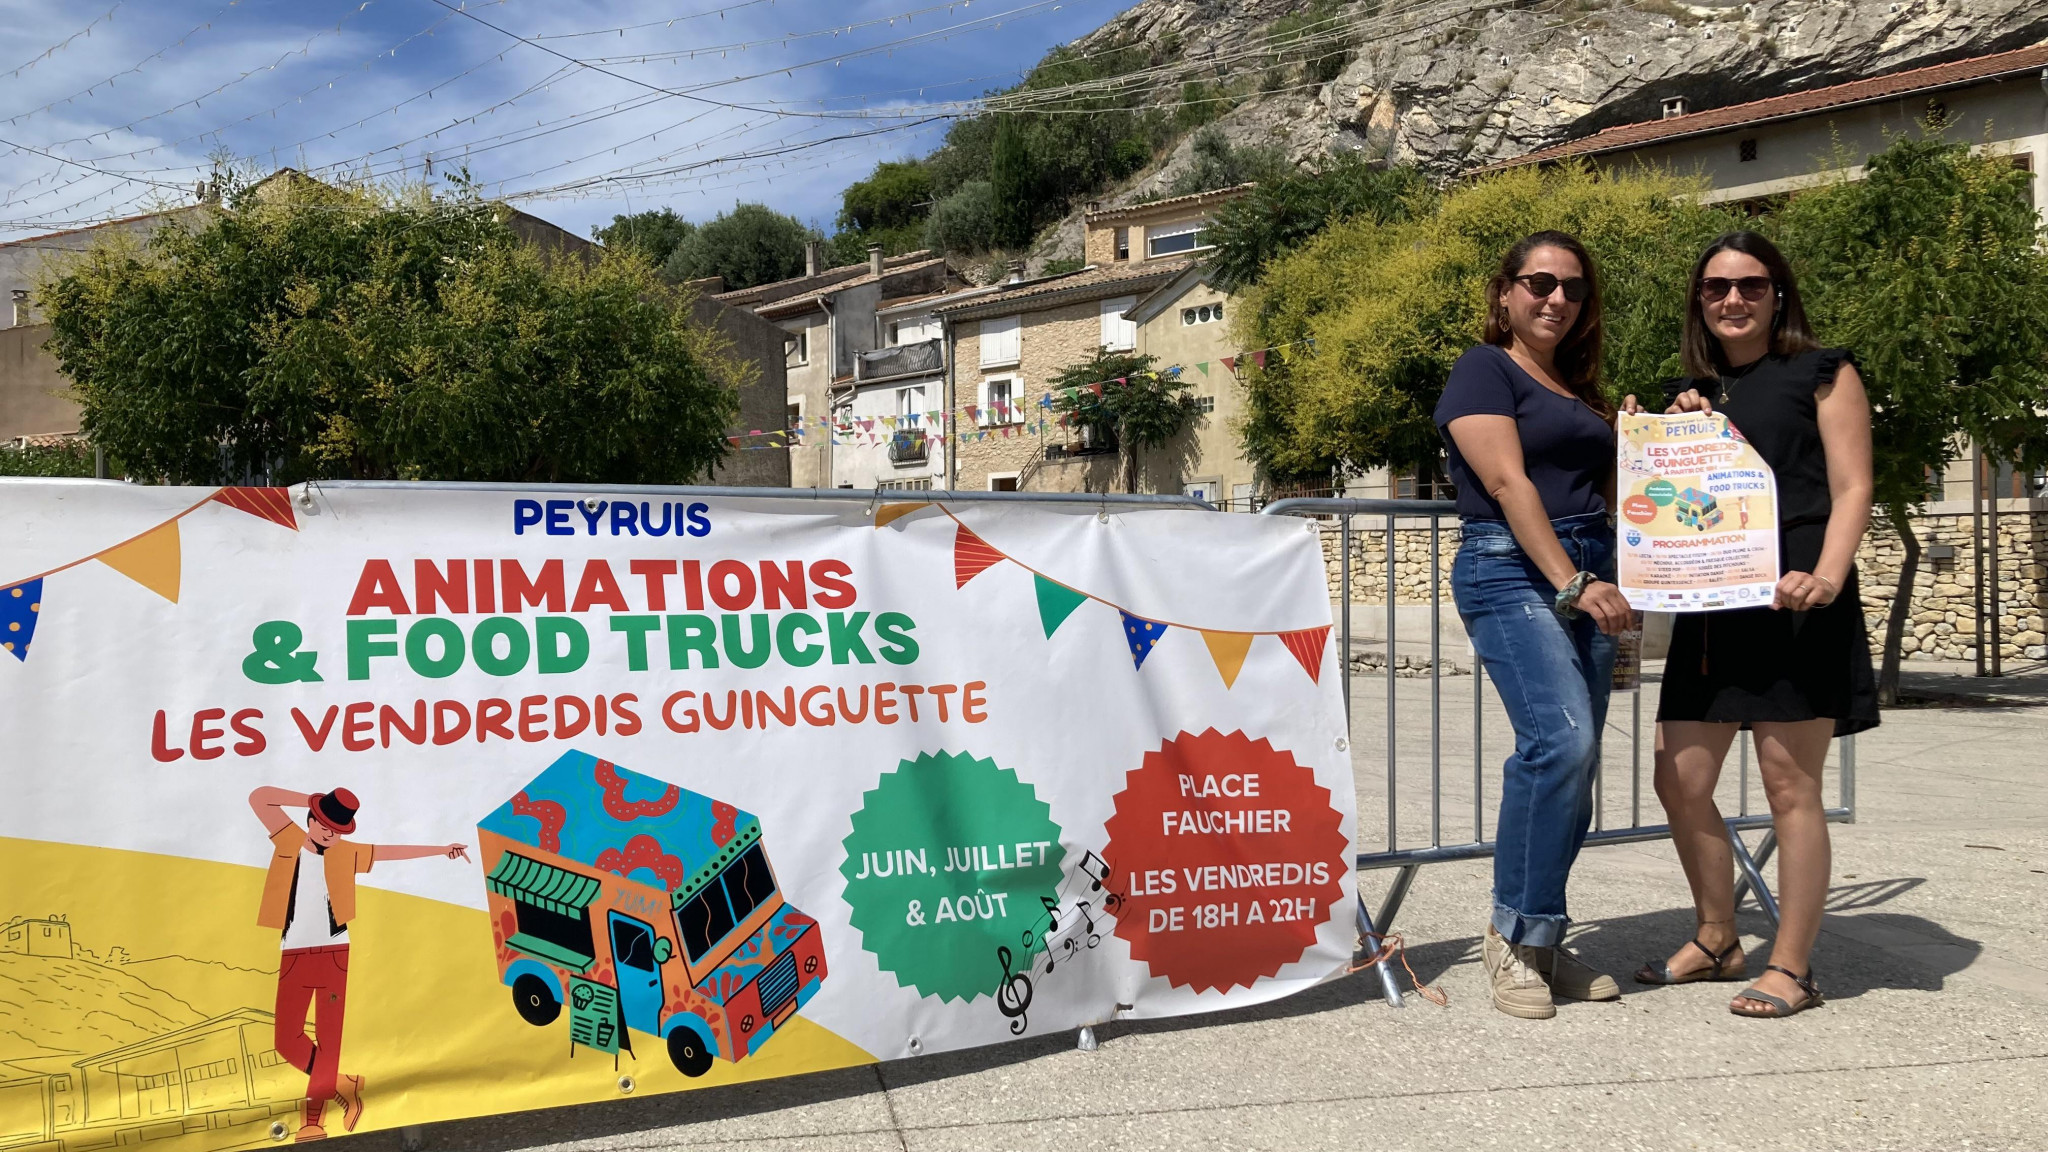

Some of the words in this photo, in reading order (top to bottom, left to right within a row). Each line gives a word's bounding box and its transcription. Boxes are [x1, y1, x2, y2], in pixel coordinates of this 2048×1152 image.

[1666, 422, 1716, 437] PEYRUIS
[1647, 447, 1669, 457] LES
[1671, 442, 1738, 456] VENDREDIS
[1654, 453, 1733, 468] GUINGUETTE
[1707, 470, 1756, 481] ANIMATIONS
[1709, 483, 1730, 493] FOOD
[1732, 482, 1765, 490] TRUCKS
[514, 499, 711, 538] PEYRUIS
[1653, 534, 1746, 549] PROGRAMMATION
[347, 558, 857, 615] ANIMATIONS
[242, 620, 323, 684] &
[346, 615, 590, 681] FOOD
[609, 611, 920, 672] TRUCKS
[152, 708, 266, 762] LES
[291, 692, 642, 752] VENDREDIS
[662, 681, 988, 734] GUINGUETTE
[1178, 773, 1260, 798] PLACE
[1162, 809, 1291, 836] FAUCHIER
[856, 849, 937, 879] JUIN,
[944, 841, 1051, 872] JUILLET
[1130, 869, 1176, 897] LES
[1183, 862, 1330, 891] VENDREDIS
[906, 899, 926, 927] &
[935, 889, 1008, 924] AOÛT
[1149, 907, 1185, 933] DE
[1192, 903, 1239, 929] 18H
[1246, 901, 1265, 925] A
[1269, 898, 1315, 923] 22H
